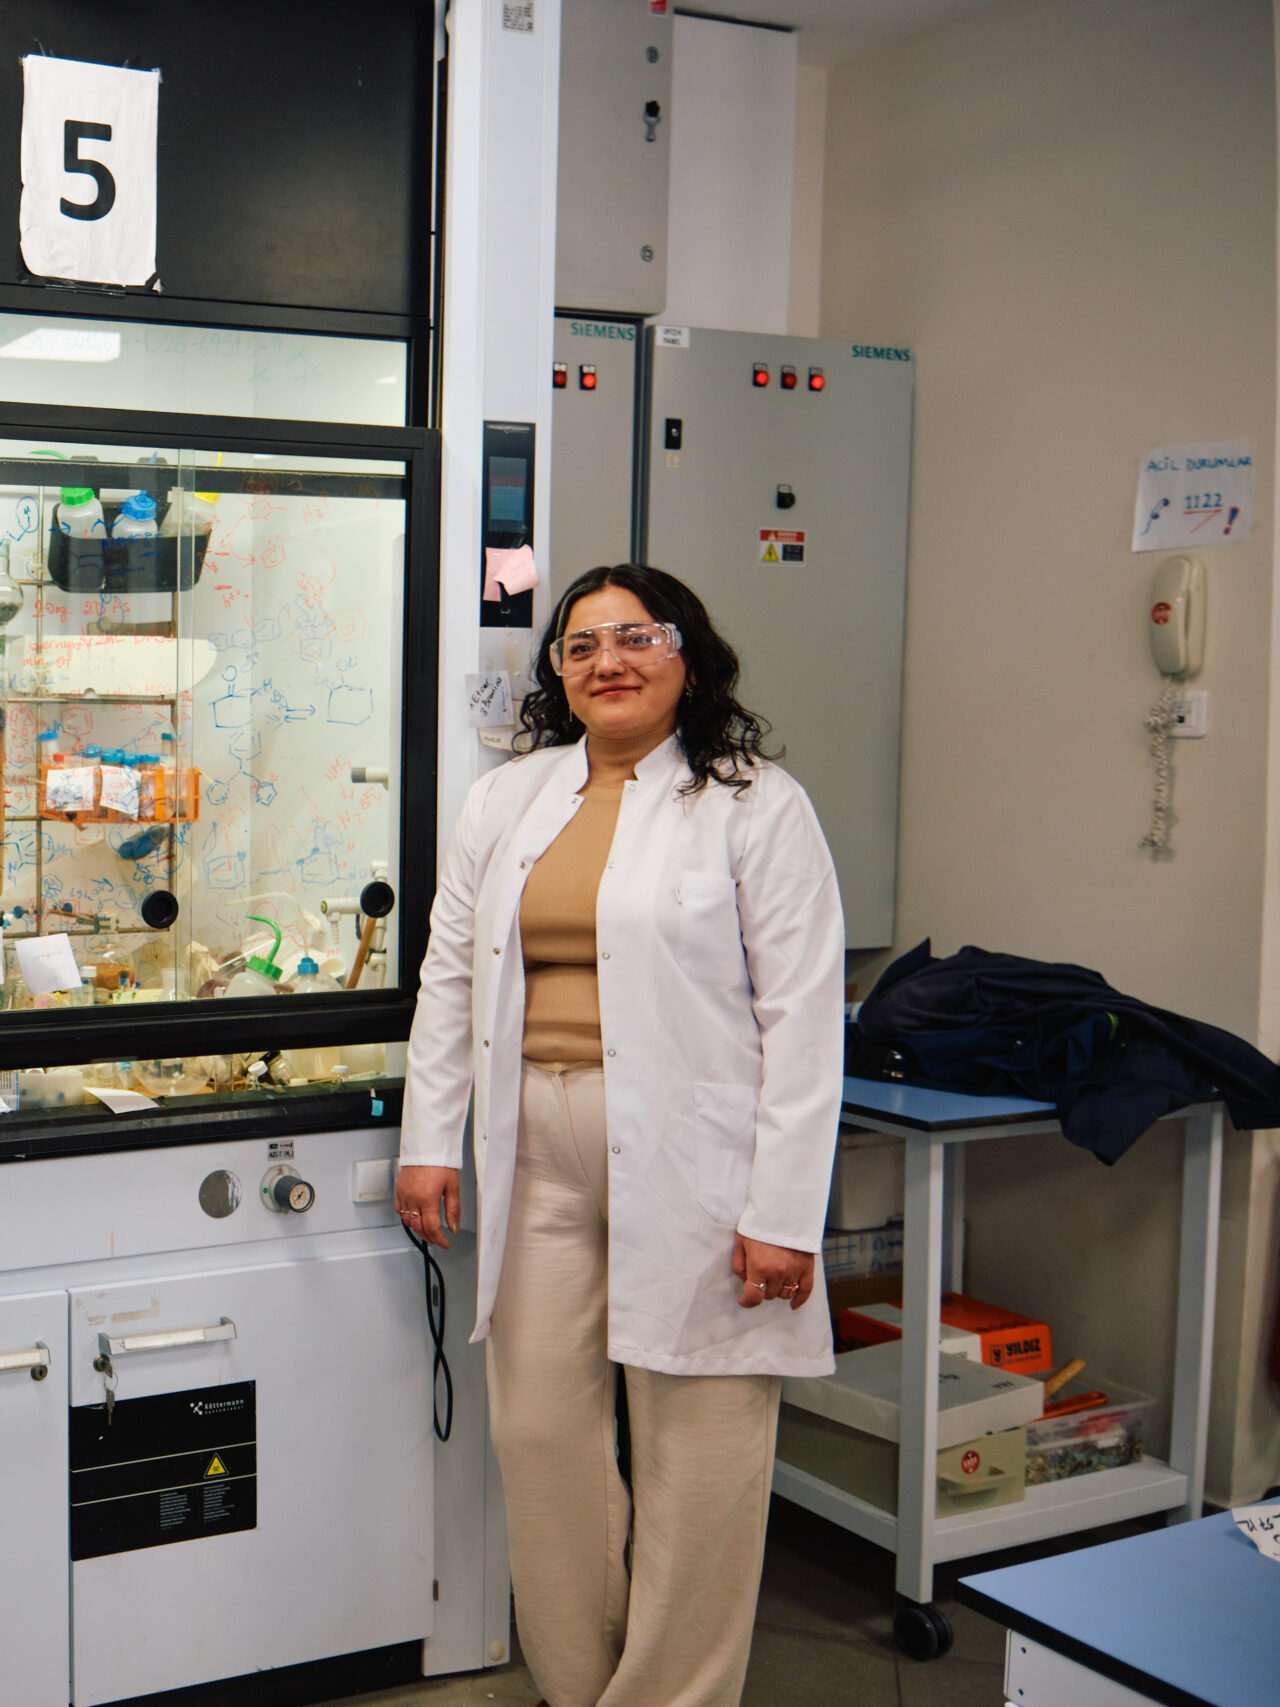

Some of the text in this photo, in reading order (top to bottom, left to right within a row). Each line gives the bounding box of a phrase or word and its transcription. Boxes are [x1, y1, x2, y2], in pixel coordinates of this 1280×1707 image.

[60, 119, 117, 222] 5
[570, 321, 636, 341] SIEMENS
[851, 344, 912, 362] SIEMENS
[1185, 492, 1225, 510] 1122
[1005, 1337, 1042, 1357] YILDIZ
[204, 1399, 244, 1410] Köttermann
